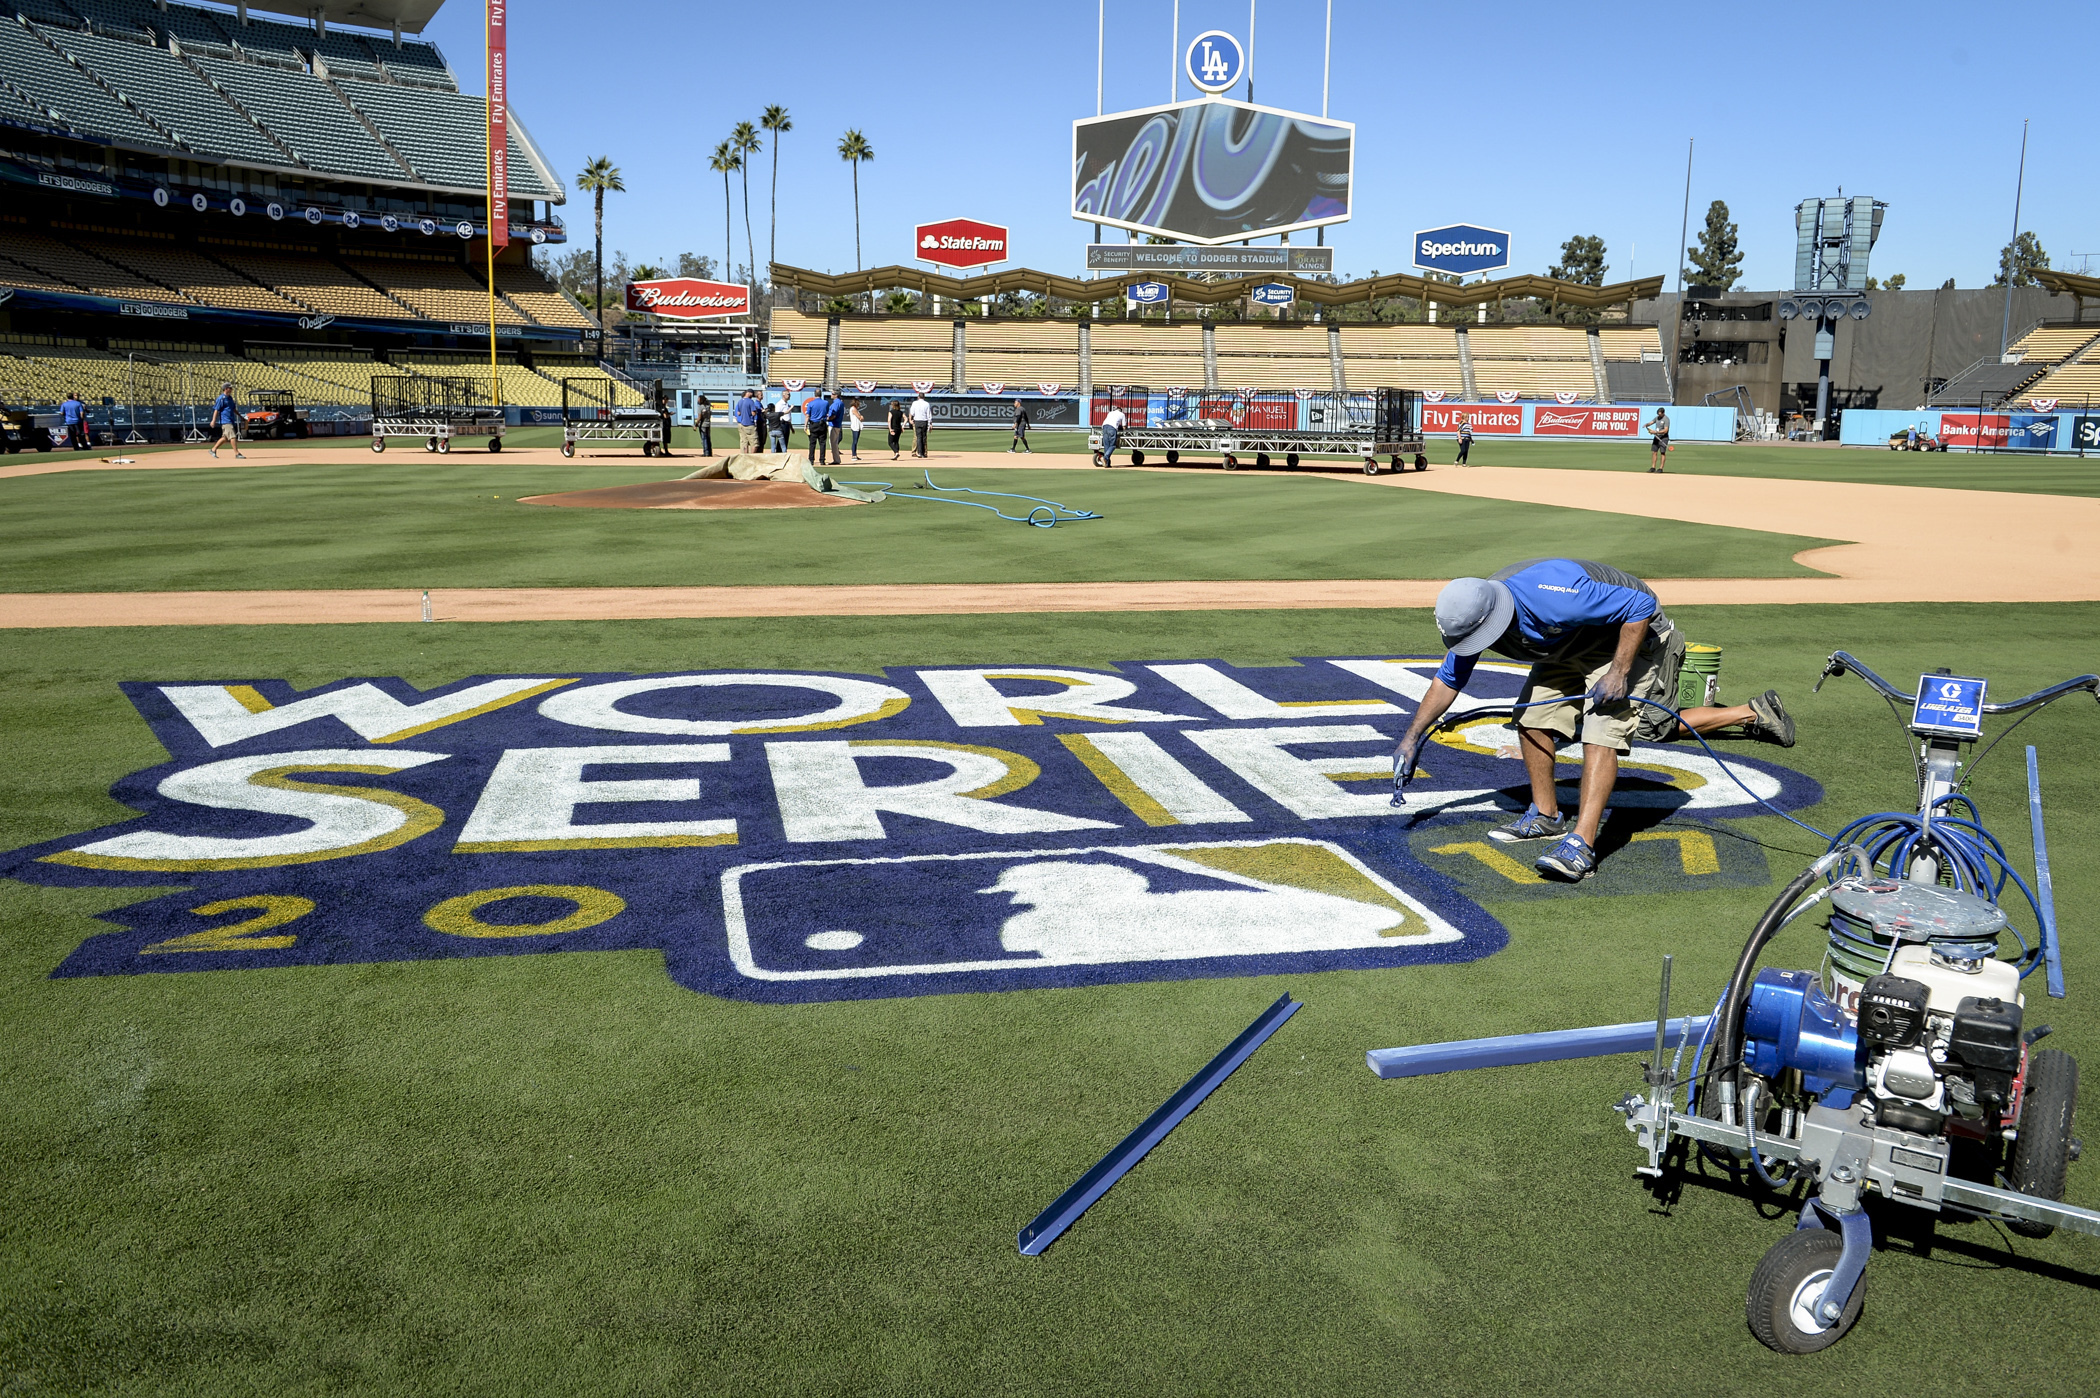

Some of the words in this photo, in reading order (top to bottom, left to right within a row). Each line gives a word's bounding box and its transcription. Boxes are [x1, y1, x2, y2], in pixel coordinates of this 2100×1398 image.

[1201, 41, 1228, 81] LA
[491, 52, 503, 102] Emirates
[492, 102, 505, 124] Fly
[493, 149, 504, 196] Emirates
[39, 173, 60, 185] LET'S
[62, 177, 75, 188] GO
[76, 180, 112, 194] DODGERS
[494, 199, 506, 220] Fly
[1421, 240, 1496, 259] Spectrum
[1136, 253, 1182, 262] WELCOME
[1185, 254, 1197, 262] TO
[1201, 254, 1238, 263] DODGER
[1241, 255, 1283, 263] STADIUM
[631, 288, 746, 309] Budweiser
[120, 304, 140, 315] LET'S
[142, 306, 153, 316] GO
[153, 307, 188, 318] DODGERS
[450, 325, 472, 333] LET'S
[474, 326, 484, 334] GO
[486, 327, 522, 336] DDGERS
[584, 330, 600, 339] 1:49
[933, 405, 948, 417] GO
[952, 405, 1015, 417] DODGERS
[1037, 403, 1067, 420] Dodgers
[1246, 406, 1287, 414] MANUEL
[1593, 411, 1611, 421] THIS
[1613, 412, 1638, 422] BUD'S
[1423, 410, 1449, 427] Fly
[1452, 410, 1519, 426] Emirates
[1542, 413, 1584, 425] Budweiser
[1592, 421, 1609, 430] FOR
[1611, 422, 1628, 431] YOU.
[1943, 424, 1968, 435] Bank
[1982, 425, 2025, 437] America
[1538, 584, 1566, 594] balance
[33, 714, 1783, 868] SERIES
